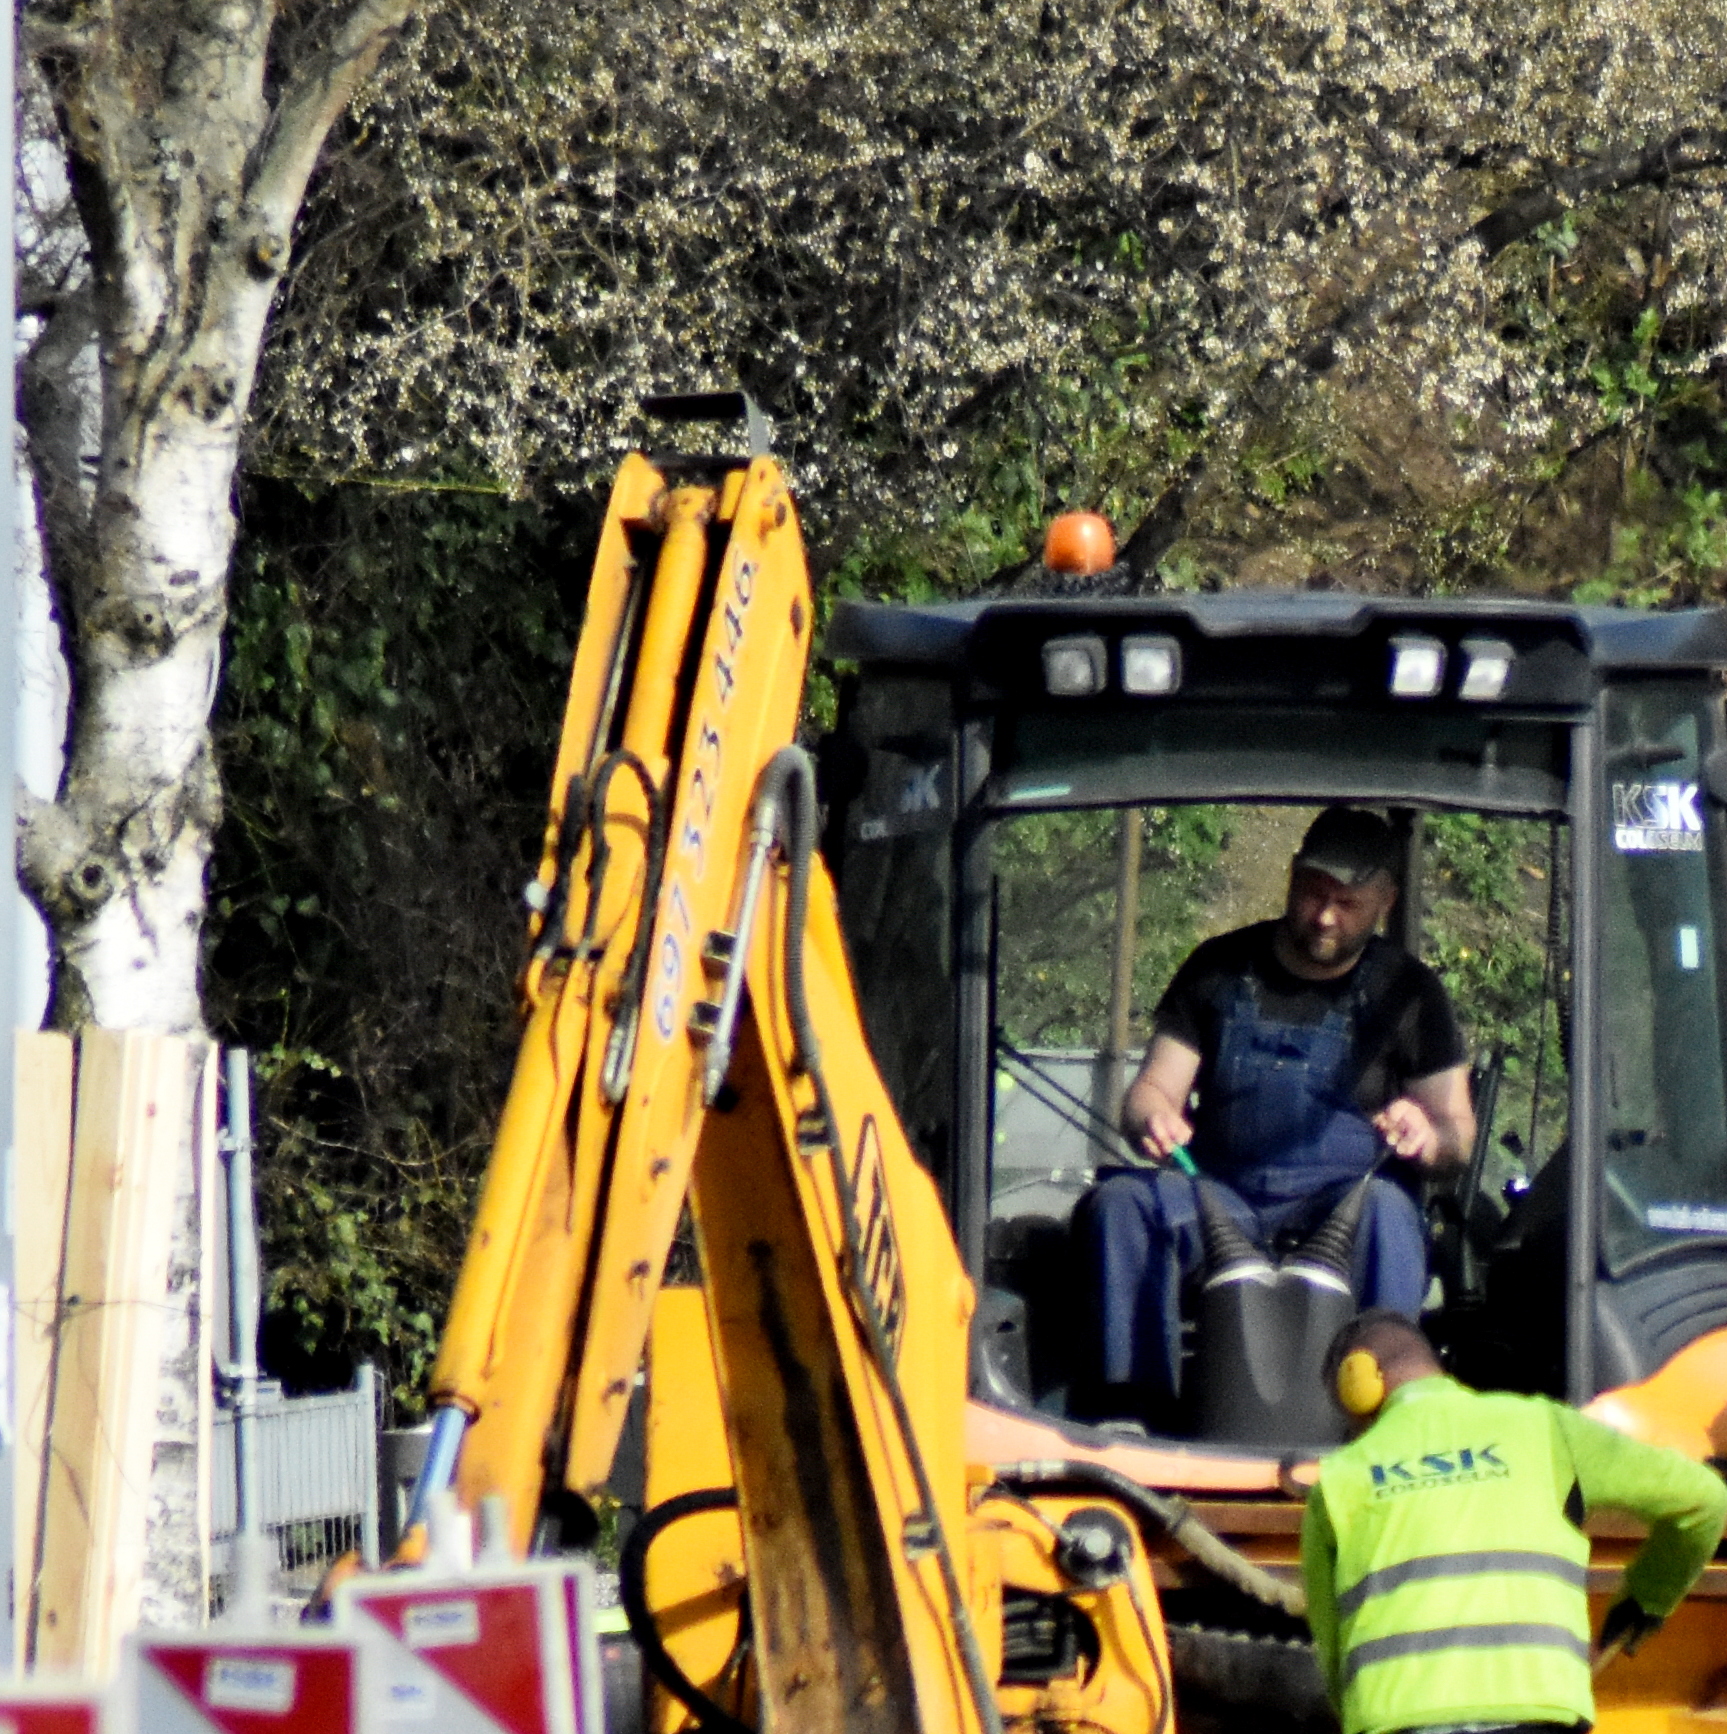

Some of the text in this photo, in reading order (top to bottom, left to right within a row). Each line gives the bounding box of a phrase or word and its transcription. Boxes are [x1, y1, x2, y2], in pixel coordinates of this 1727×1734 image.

[653, 880, 690, 1041] 697
[715, 548, 758, 706] 446
[1612, 783, 1702, 831] KSK
[1368, 1443, 1510, 1487] KSK
